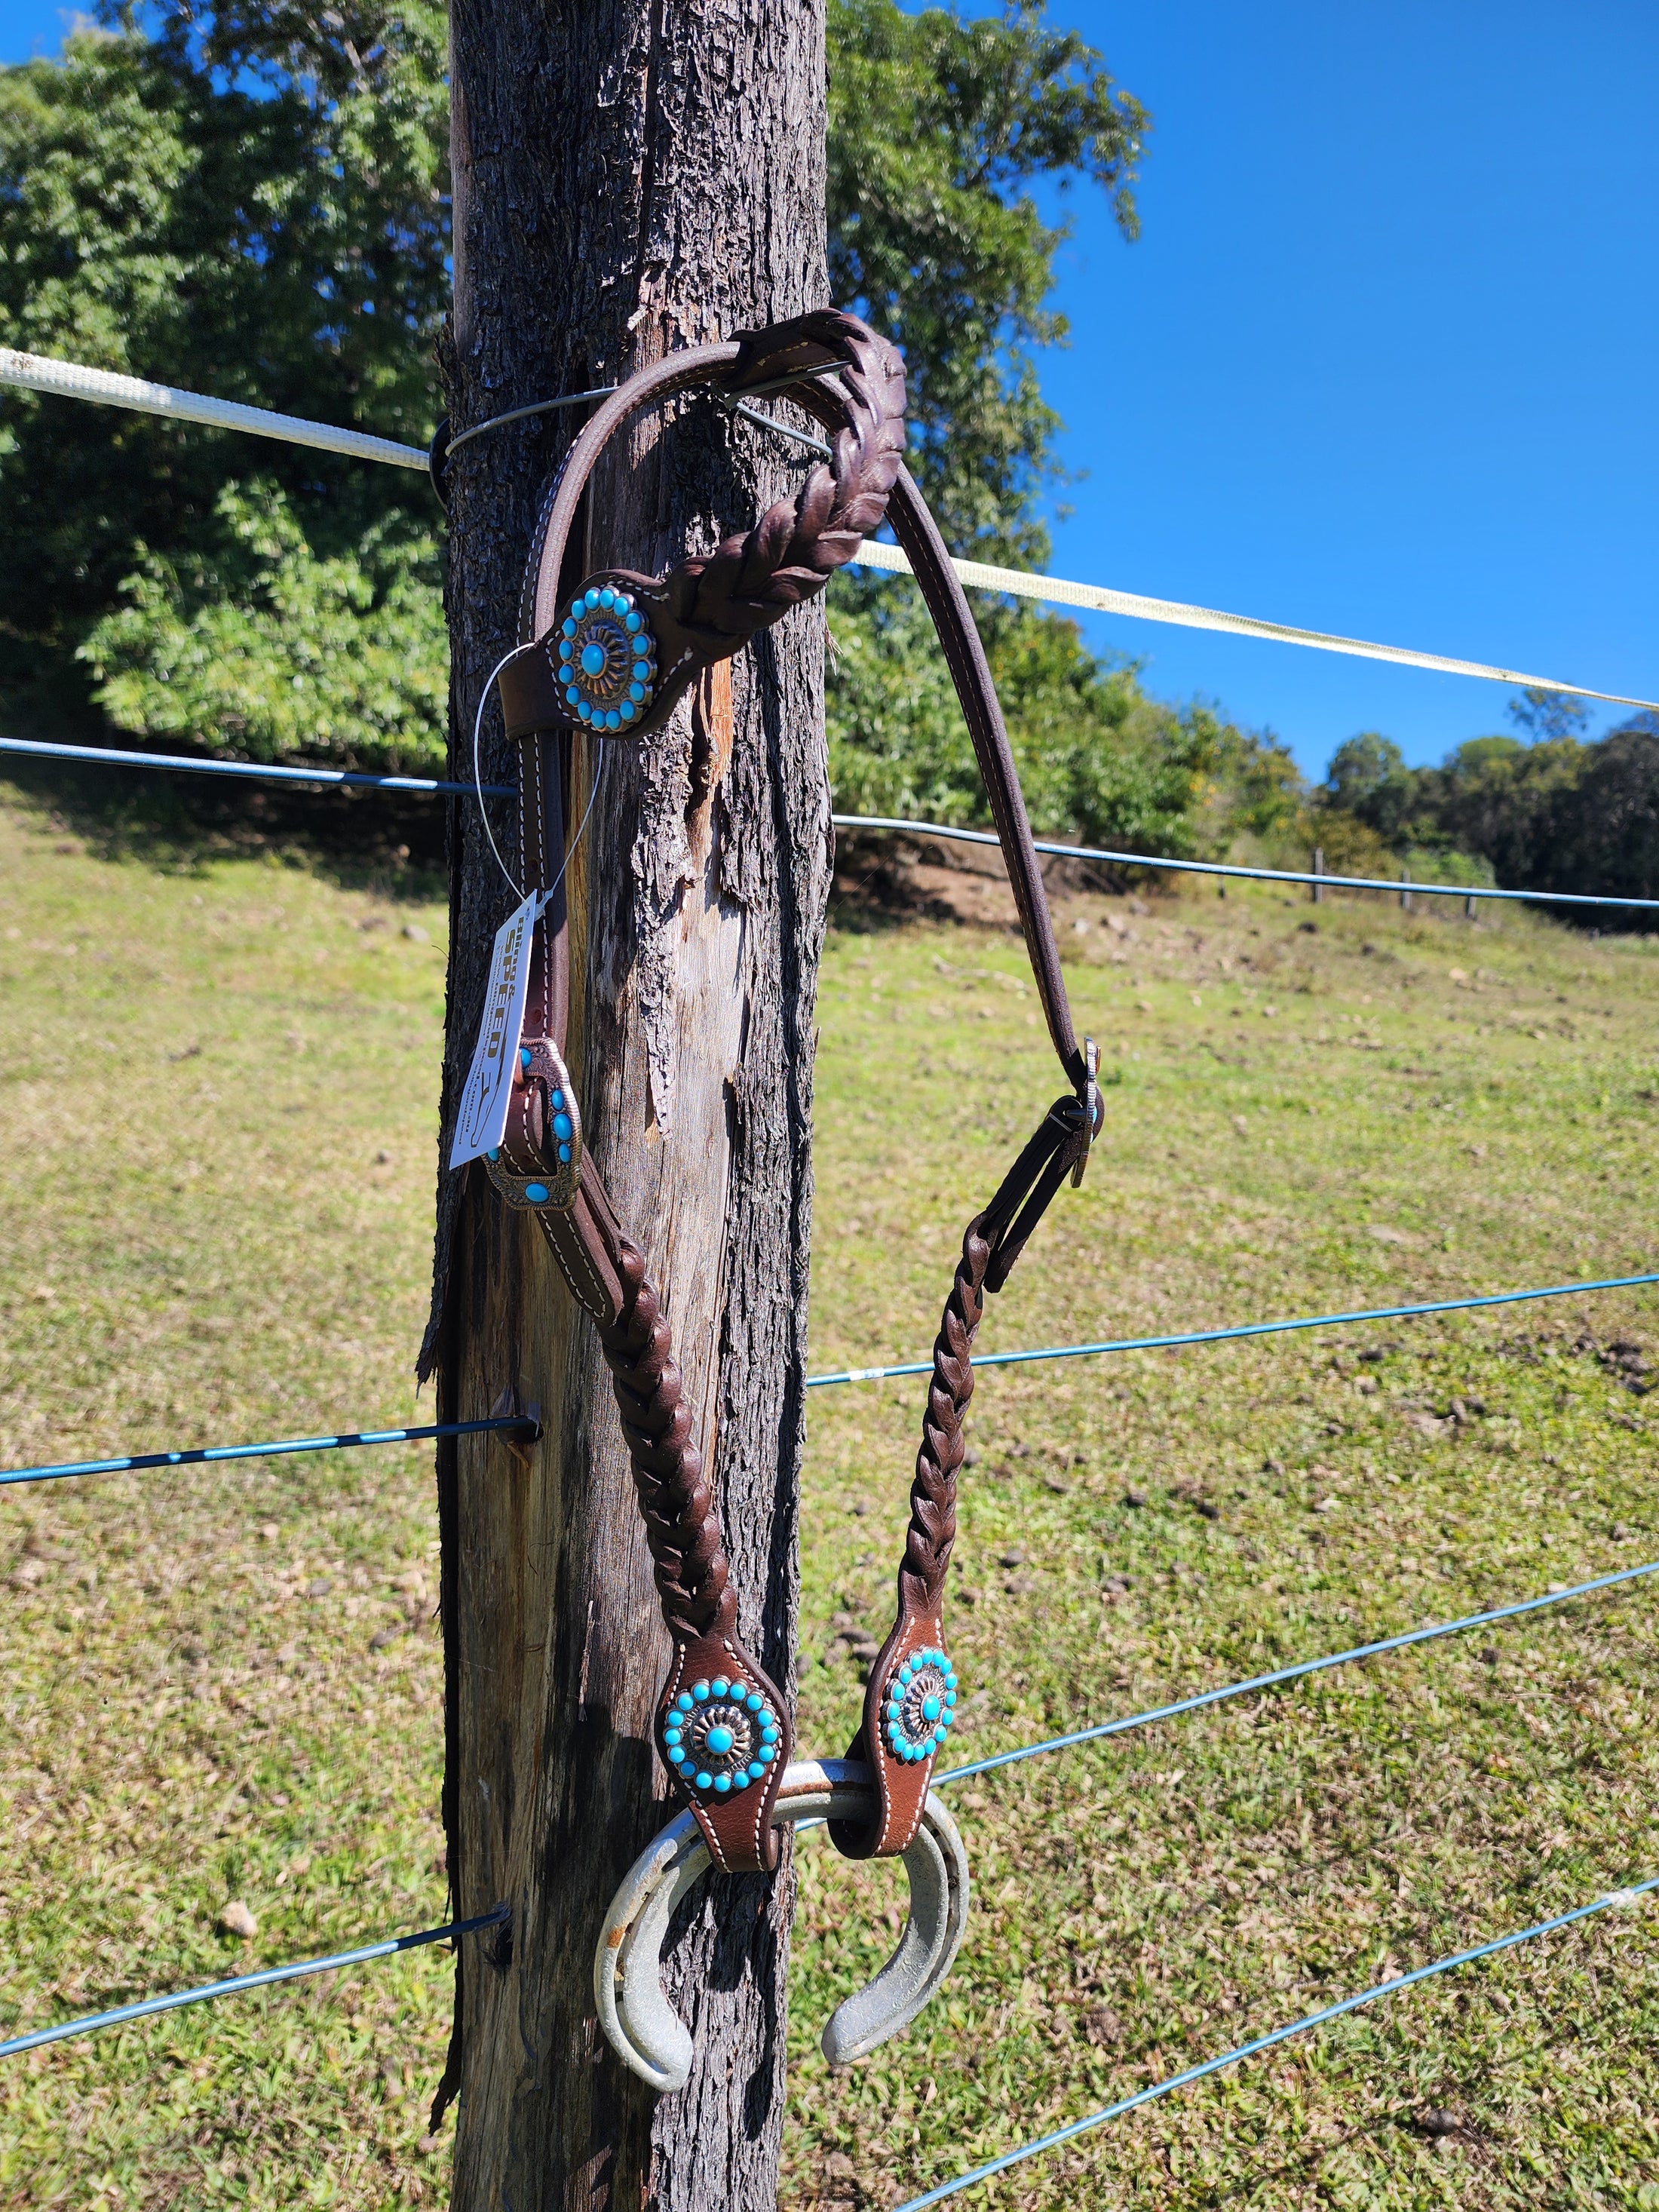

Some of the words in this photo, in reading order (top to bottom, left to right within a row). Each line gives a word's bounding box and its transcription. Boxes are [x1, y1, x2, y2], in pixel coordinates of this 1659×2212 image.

[510, 916, 524, 981] Bling
[488, 928, 516, 1058] SPEED
[508, 983, 516, 1002] &
